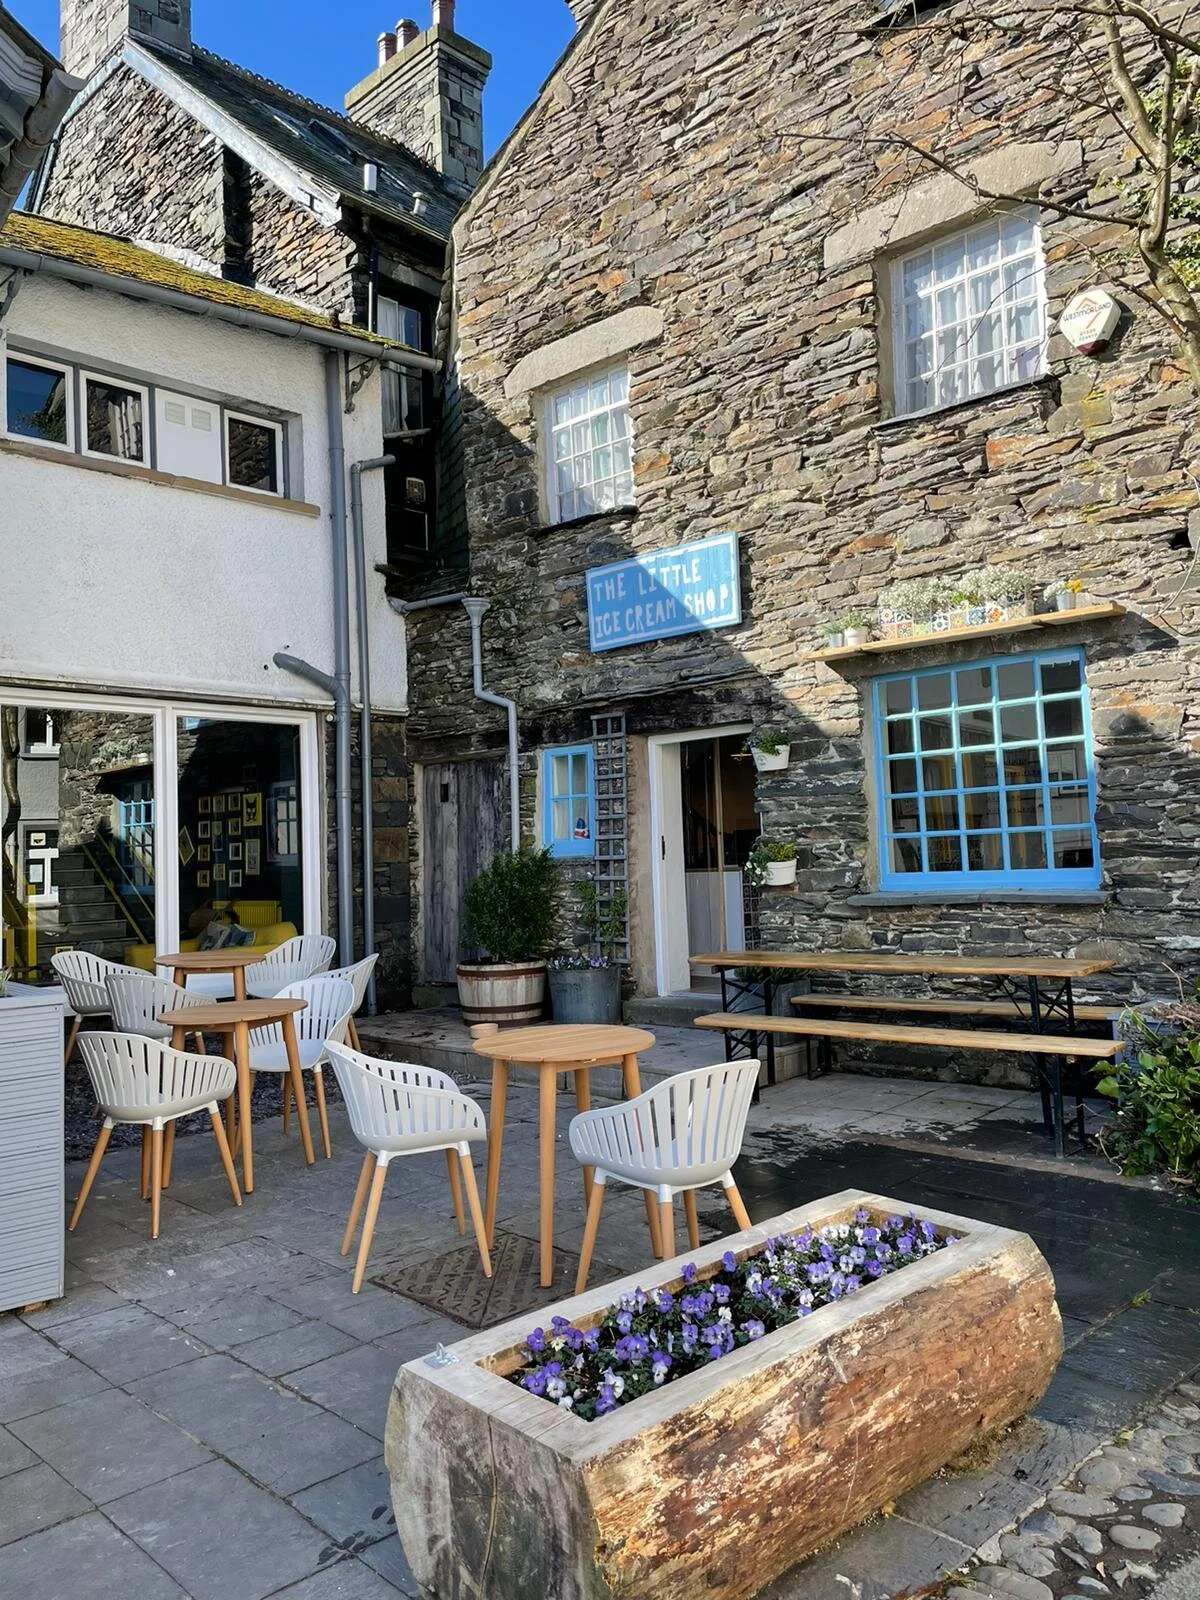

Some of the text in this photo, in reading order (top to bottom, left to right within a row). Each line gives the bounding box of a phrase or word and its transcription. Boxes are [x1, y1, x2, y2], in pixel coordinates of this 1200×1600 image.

[593, 558, 702, 602] THE LITTLE
[594, 583, 729, 638] ICE CREAM SHOP
